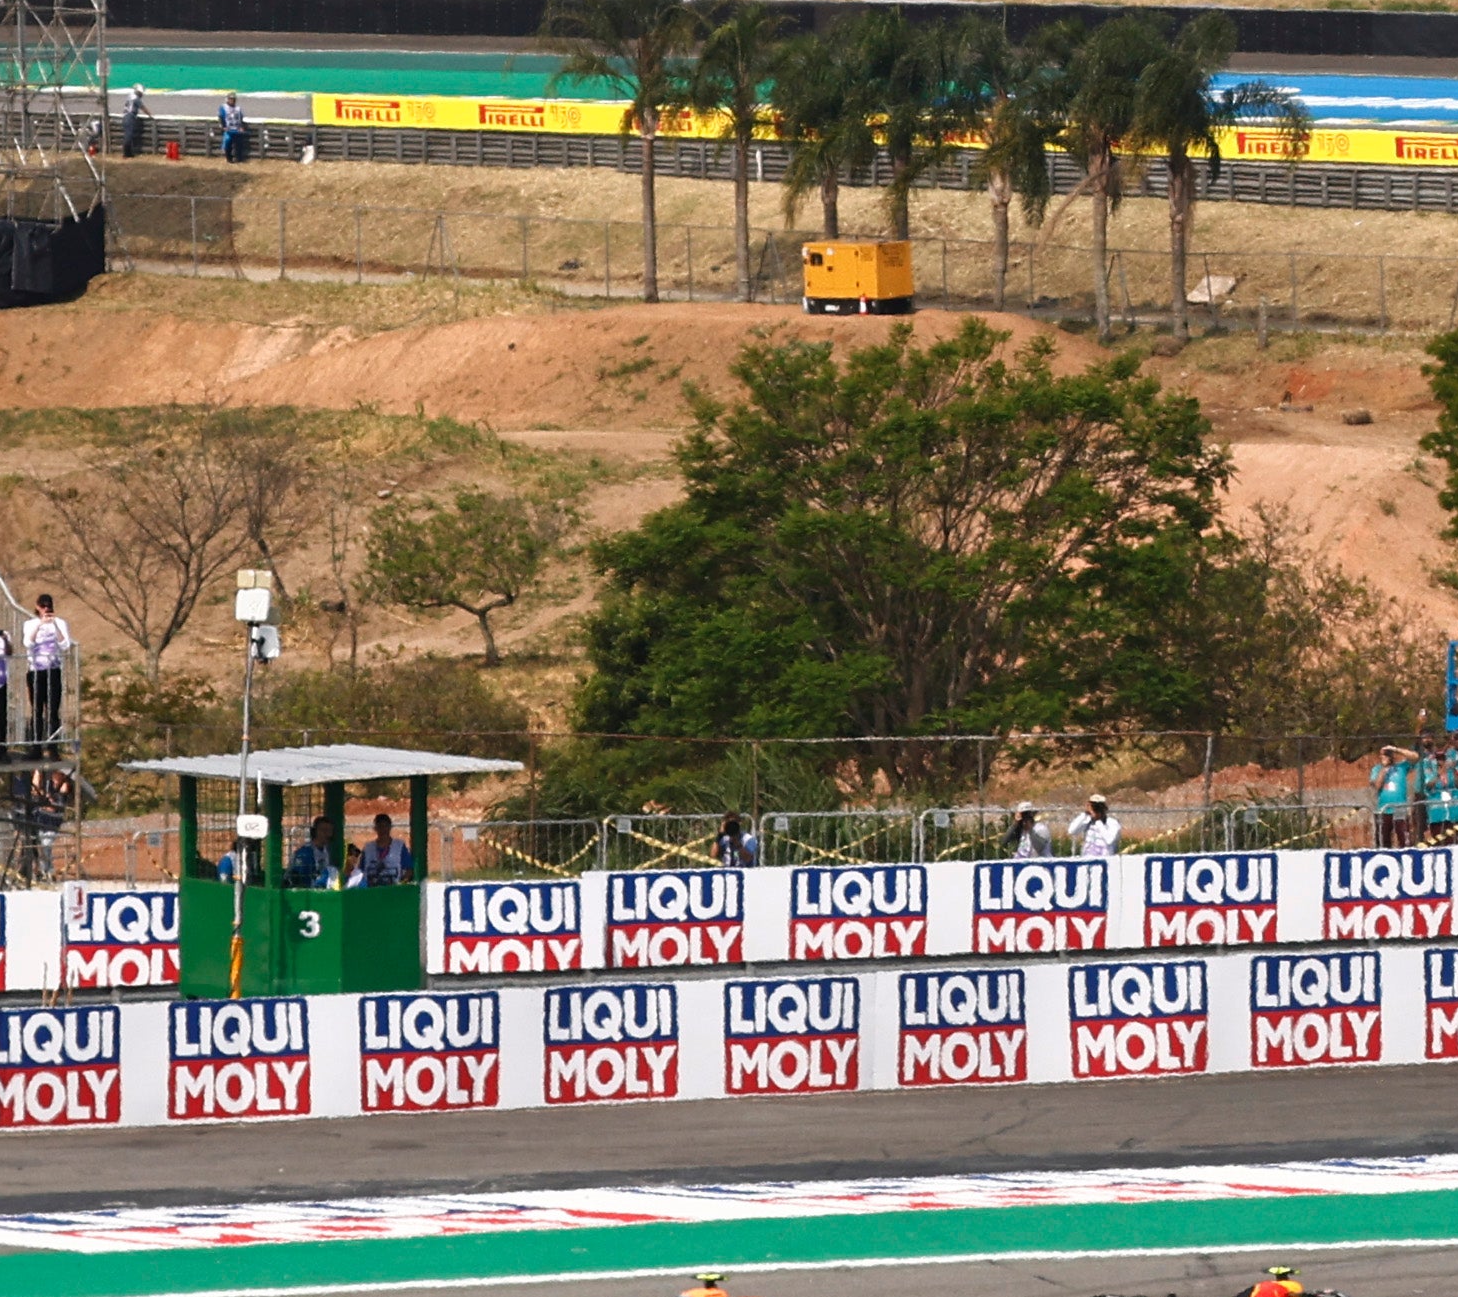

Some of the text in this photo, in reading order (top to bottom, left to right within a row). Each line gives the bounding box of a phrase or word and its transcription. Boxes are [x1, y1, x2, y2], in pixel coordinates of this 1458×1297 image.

[335, 100, 400, 122] PIRELLI
[479, 104, 544, 127] PIRELLI
[795, 869, 923, 917] LIQUI
[298, 910, 321, 939] 3
[795, 919, 923, 959] MOLY
[903, 974, 1023, 1026] LIQUI
[1256, 956, 1377, 1007] LIQUI
[173, 1002, 307, 1056] LIQUI
[549, 988, 674, 1042] LIQUI
[1256, 1009, 1377, 1063] MOLY
[549, 1044, 674, 1100] MOLY
[903, 1028, 1023, 1082] MOLY
[173, 1058, 307, 1116] MOLY
